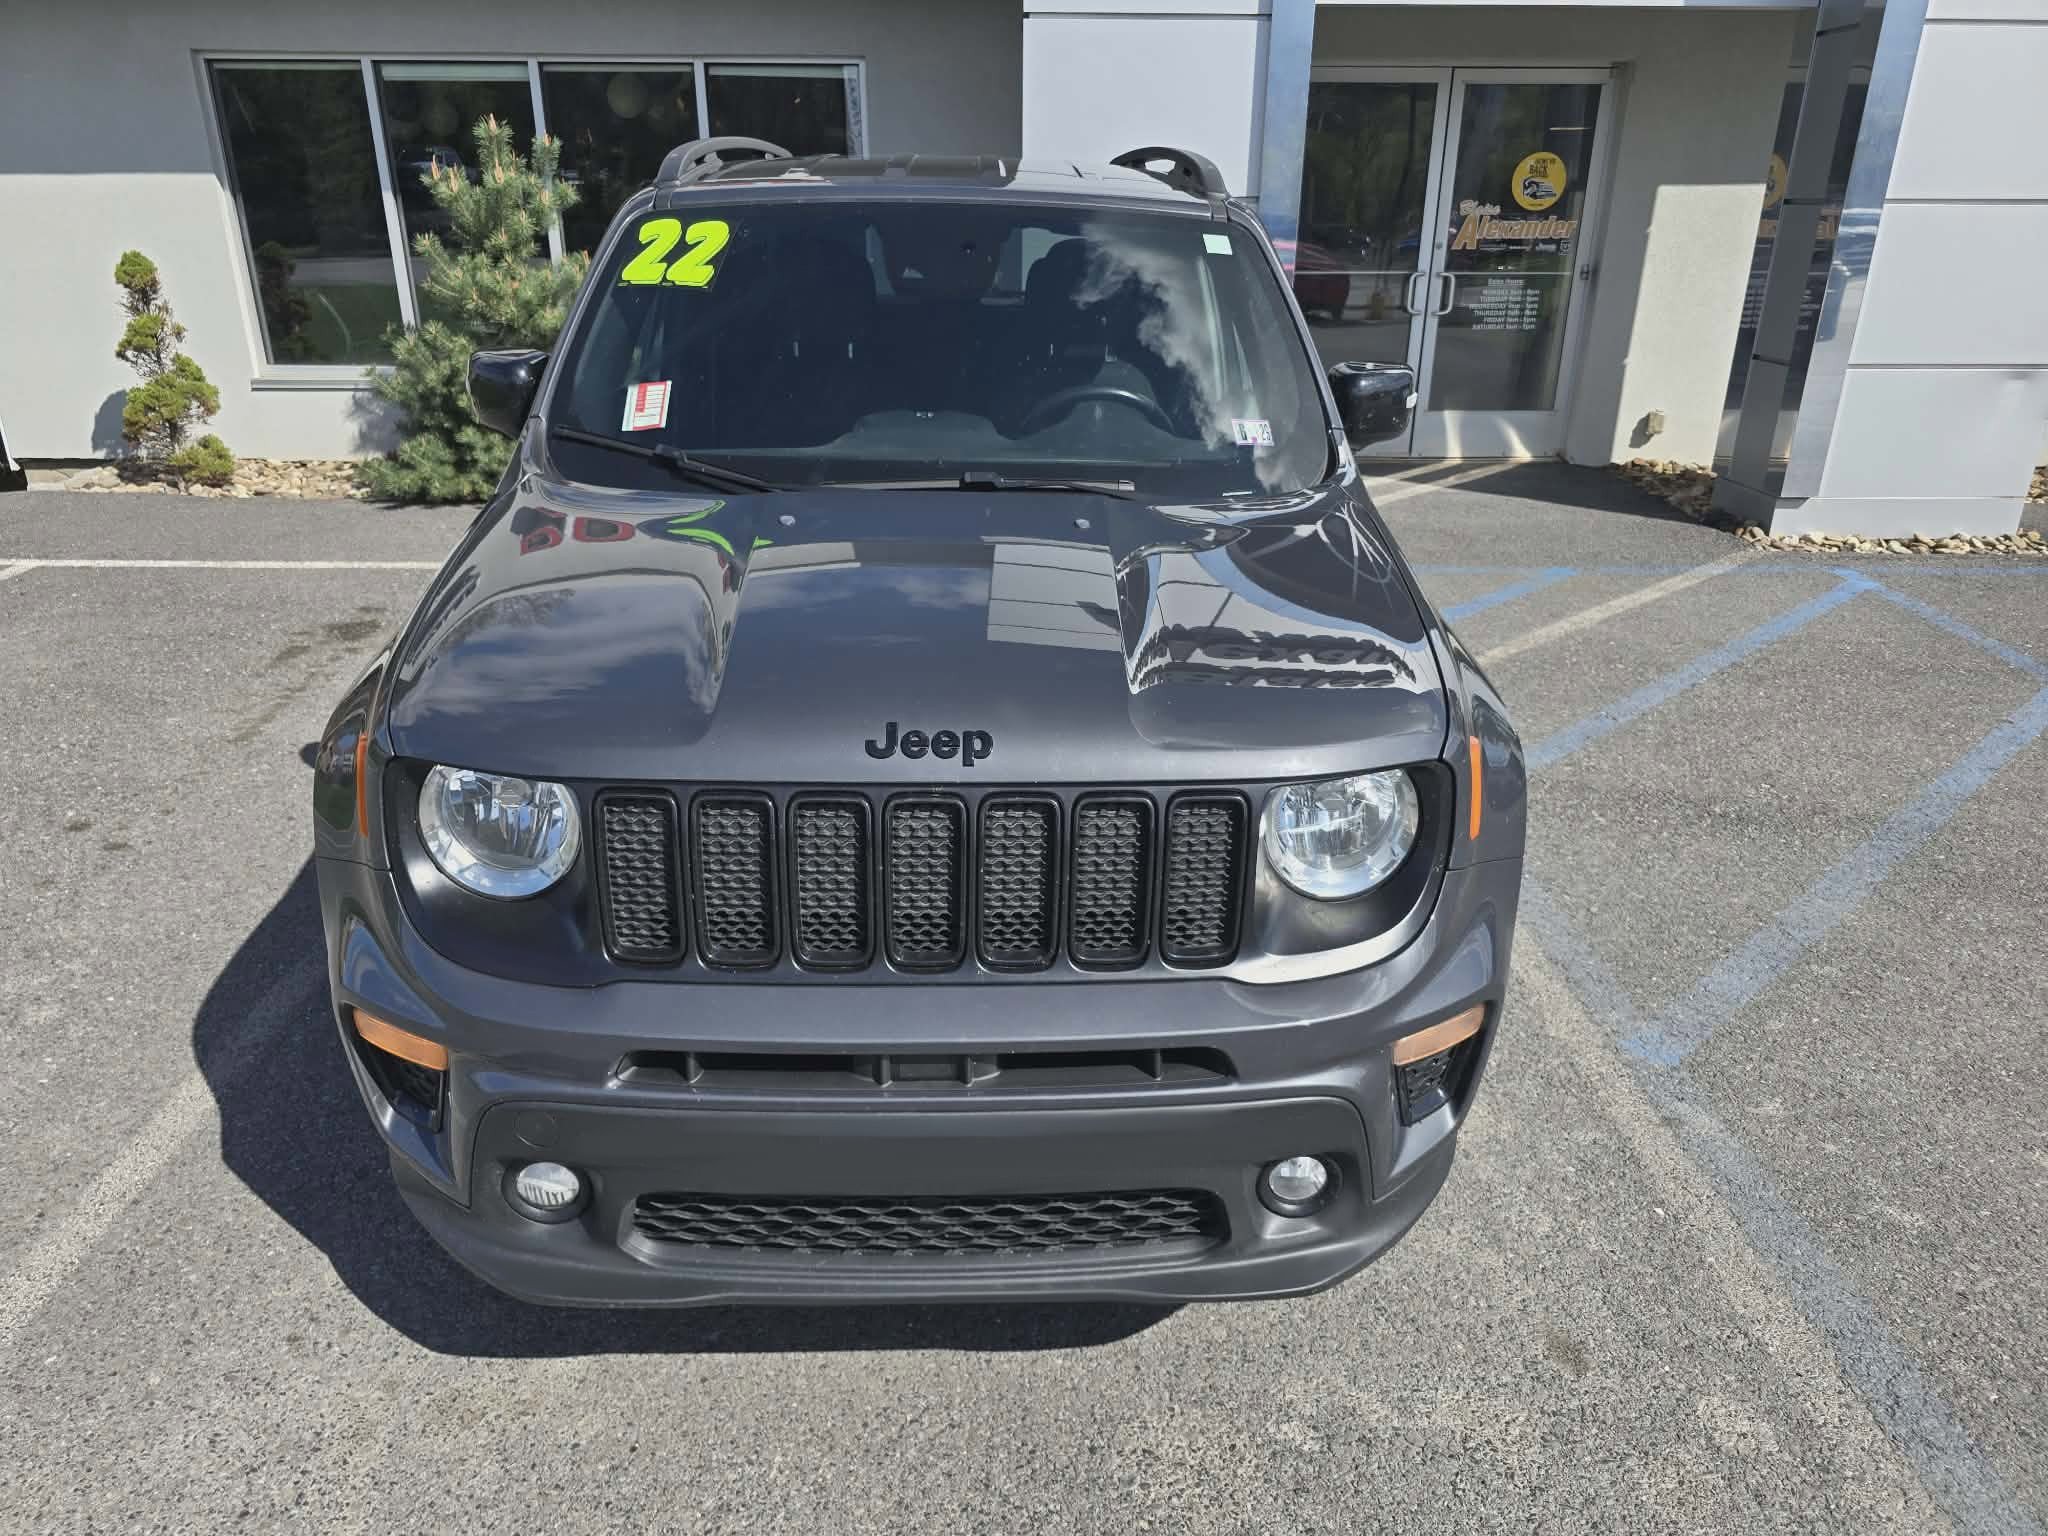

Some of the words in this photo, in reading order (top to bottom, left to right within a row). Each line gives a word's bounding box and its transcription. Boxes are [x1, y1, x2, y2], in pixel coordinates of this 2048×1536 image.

[620, 218, 730, 288] 22
[1450, 215, 1577, 250] Alexander
[865, 721, 993, 768] Jeep
